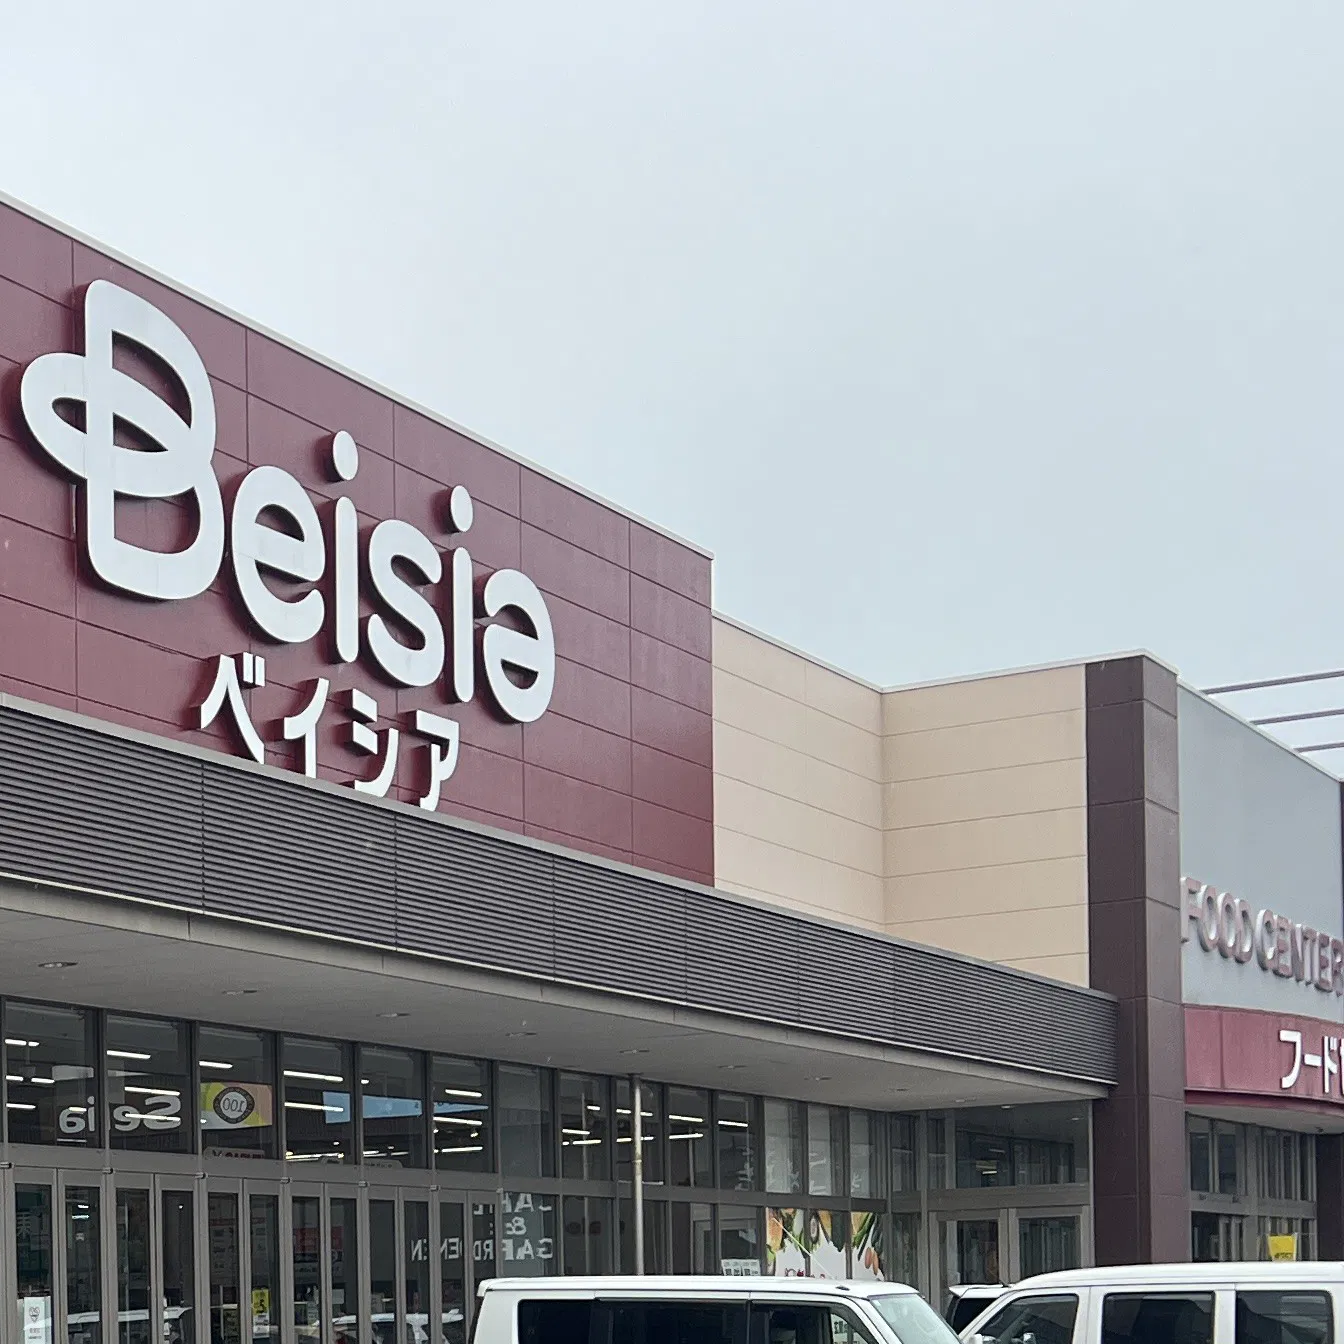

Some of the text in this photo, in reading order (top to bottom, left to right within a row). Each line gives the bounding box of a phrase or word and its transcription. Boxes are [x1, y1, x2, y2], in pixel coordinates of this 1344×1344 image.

[20, 279, 556, 723] Beisia
[199, 652, 461, 812] ベイシア
[1180, 876, 1253, 966] FOOD
